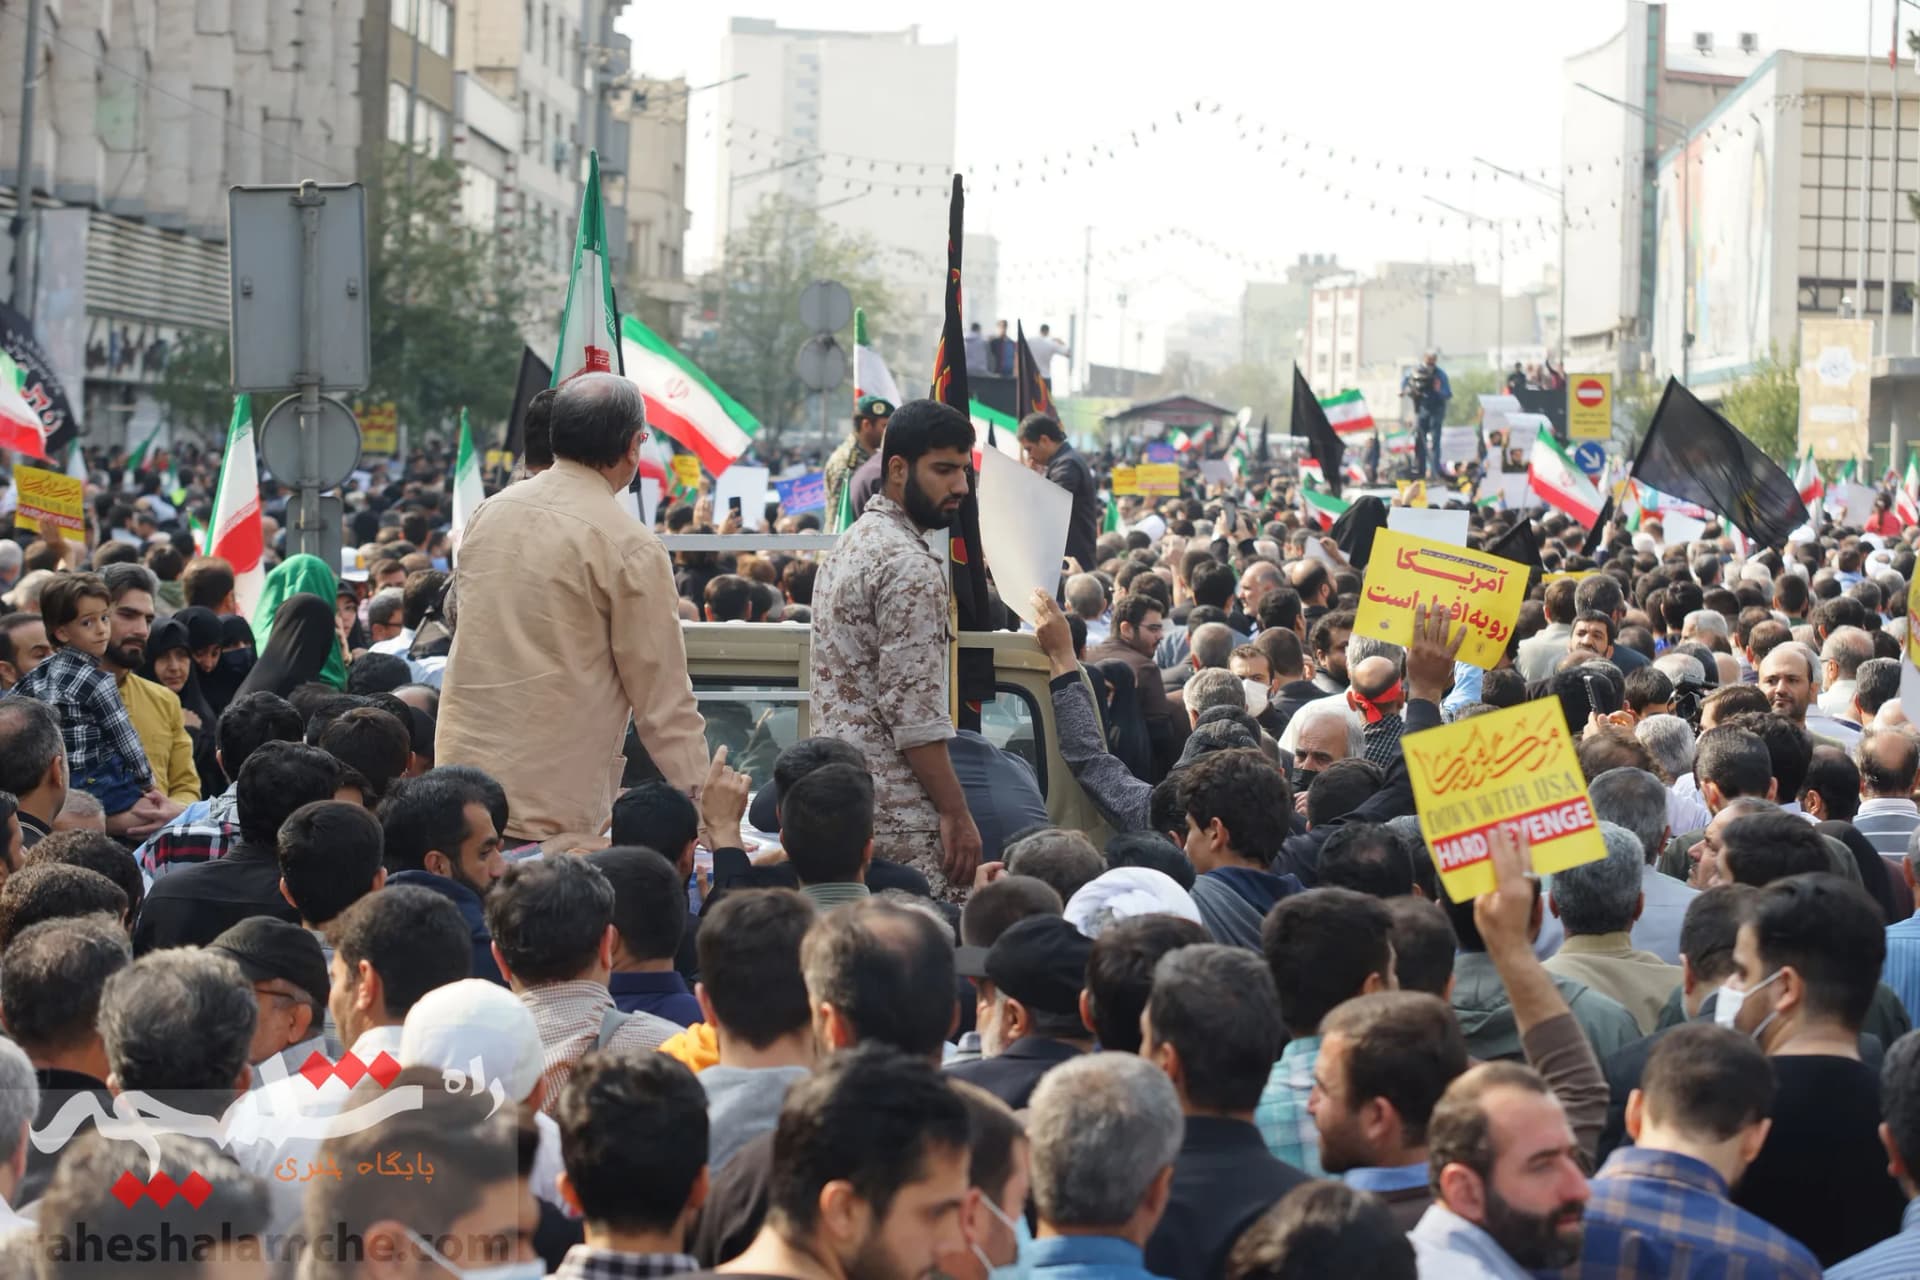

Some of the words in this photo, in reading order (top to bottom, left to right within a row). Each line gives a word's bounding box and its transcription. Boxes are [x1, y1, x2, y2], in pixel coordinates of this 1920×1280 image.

[1396, 548, 1509, 593] آمریکا
[1366, 586, 1420, 611] است
[1476, 783, 1531, 817] WITH
[1534, 771, 1580, 801] USA
[1434, 832, 1490, 869] HARD
